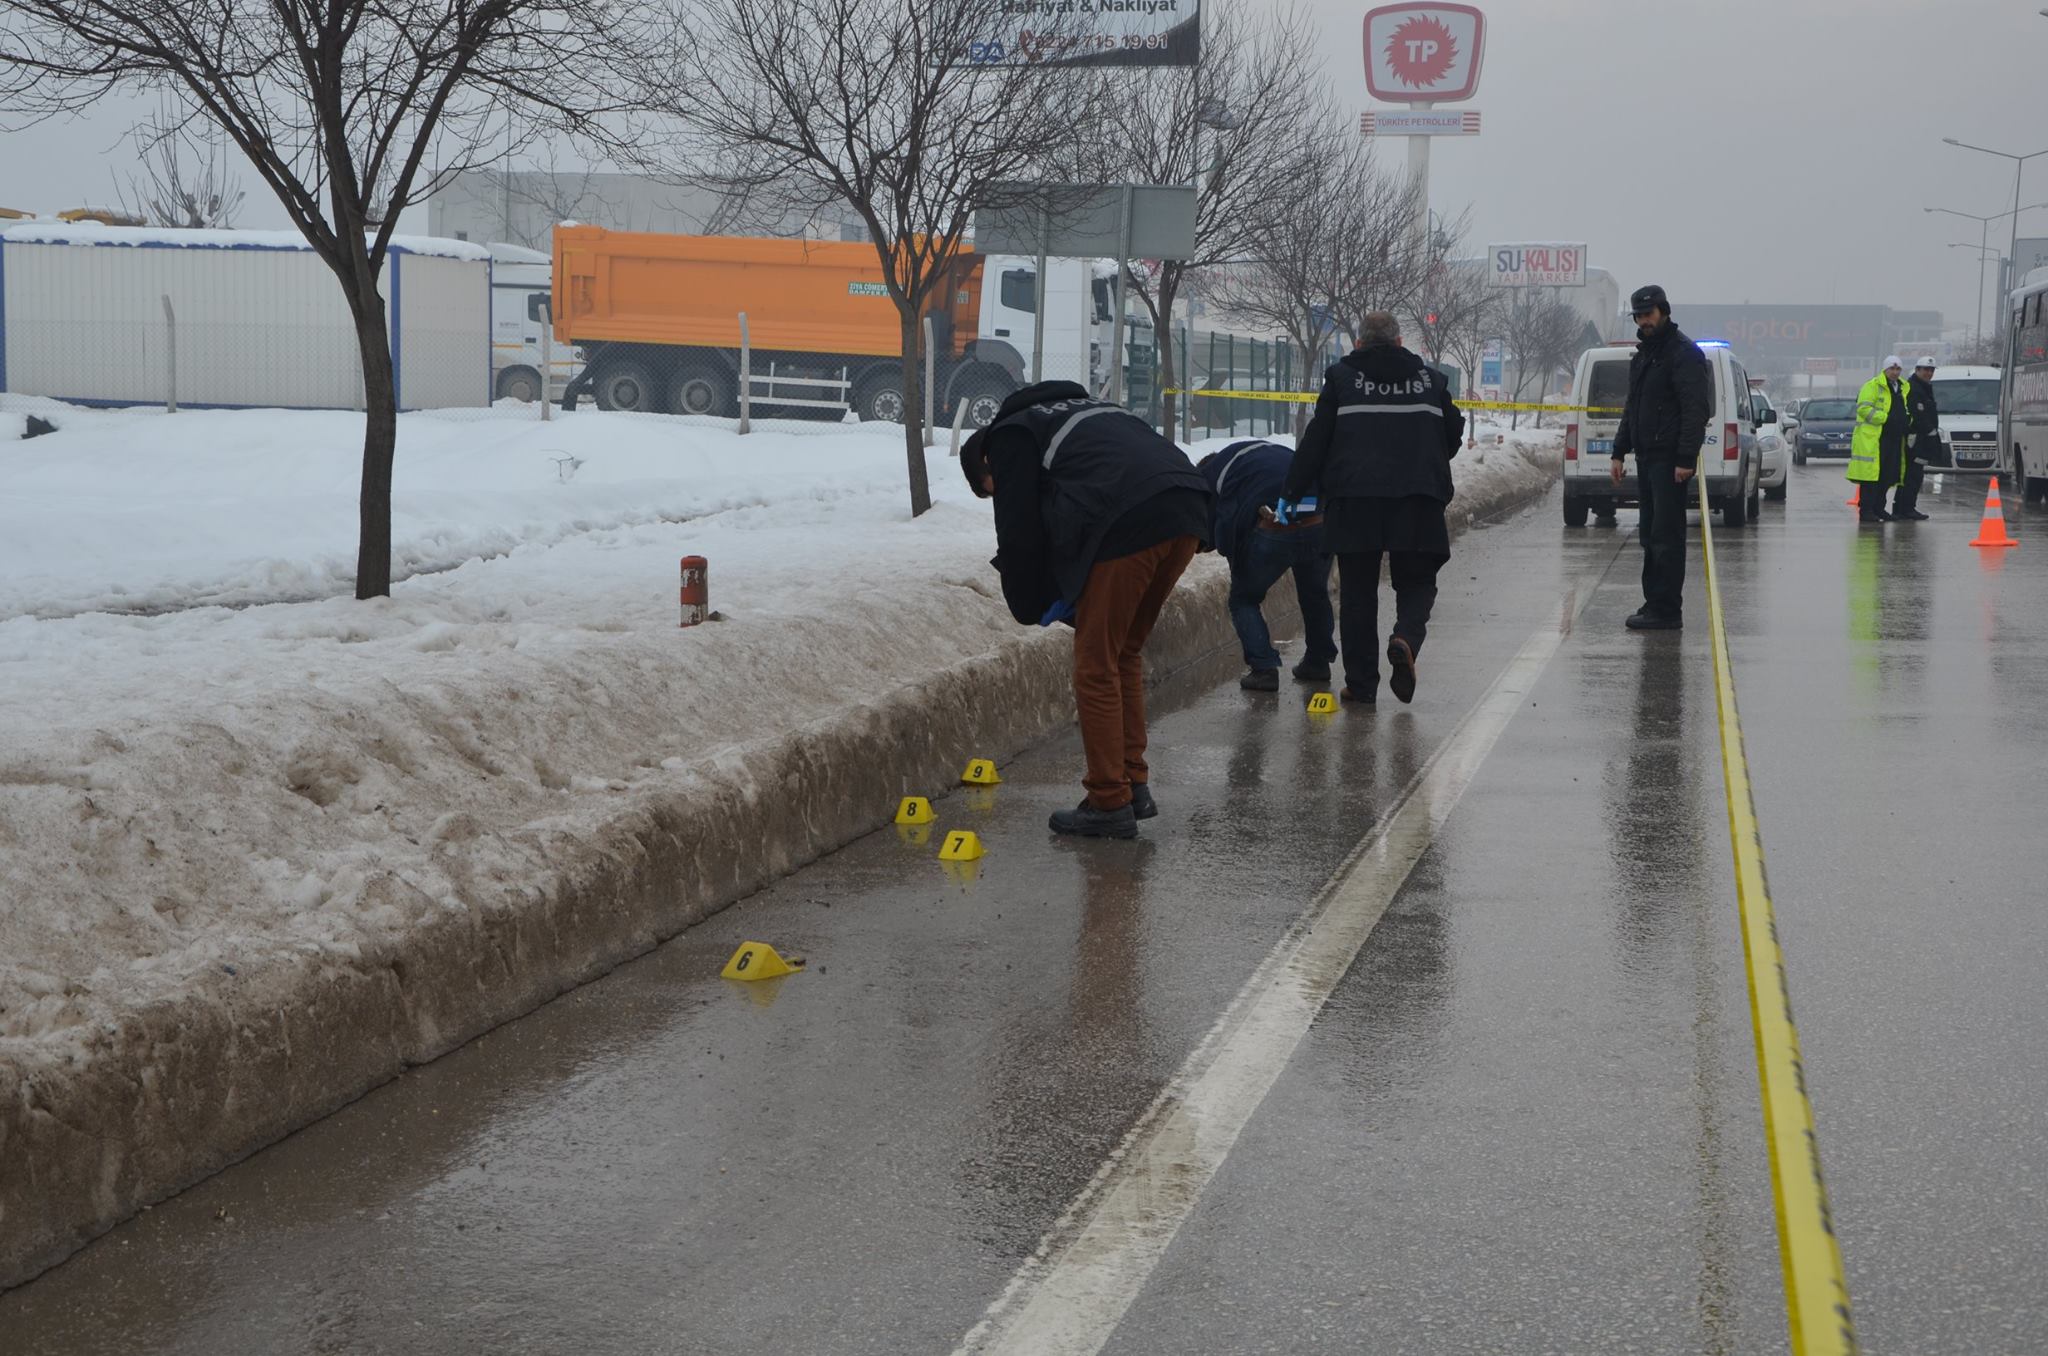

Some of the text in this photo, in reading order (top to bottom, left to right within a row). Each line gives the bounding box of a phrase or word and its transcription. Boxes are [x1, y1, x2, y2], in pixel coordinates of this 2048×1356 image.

[1084, 33, 1115, 49] 715
[1121, 33, 1143, 50] 19
[1146, 32, 1169, 49] 91
[1404, 39, 1439, 63] TP
[1497, 272, 1579, 282] YAPI MARKET
[1313, 697, 1328, 709] 10
[973, 766, 983, 778] 9
[907, 802, 917, 816] 8
[953, 837, 965, 853] 7
[737, 951, 753, 971] 6
